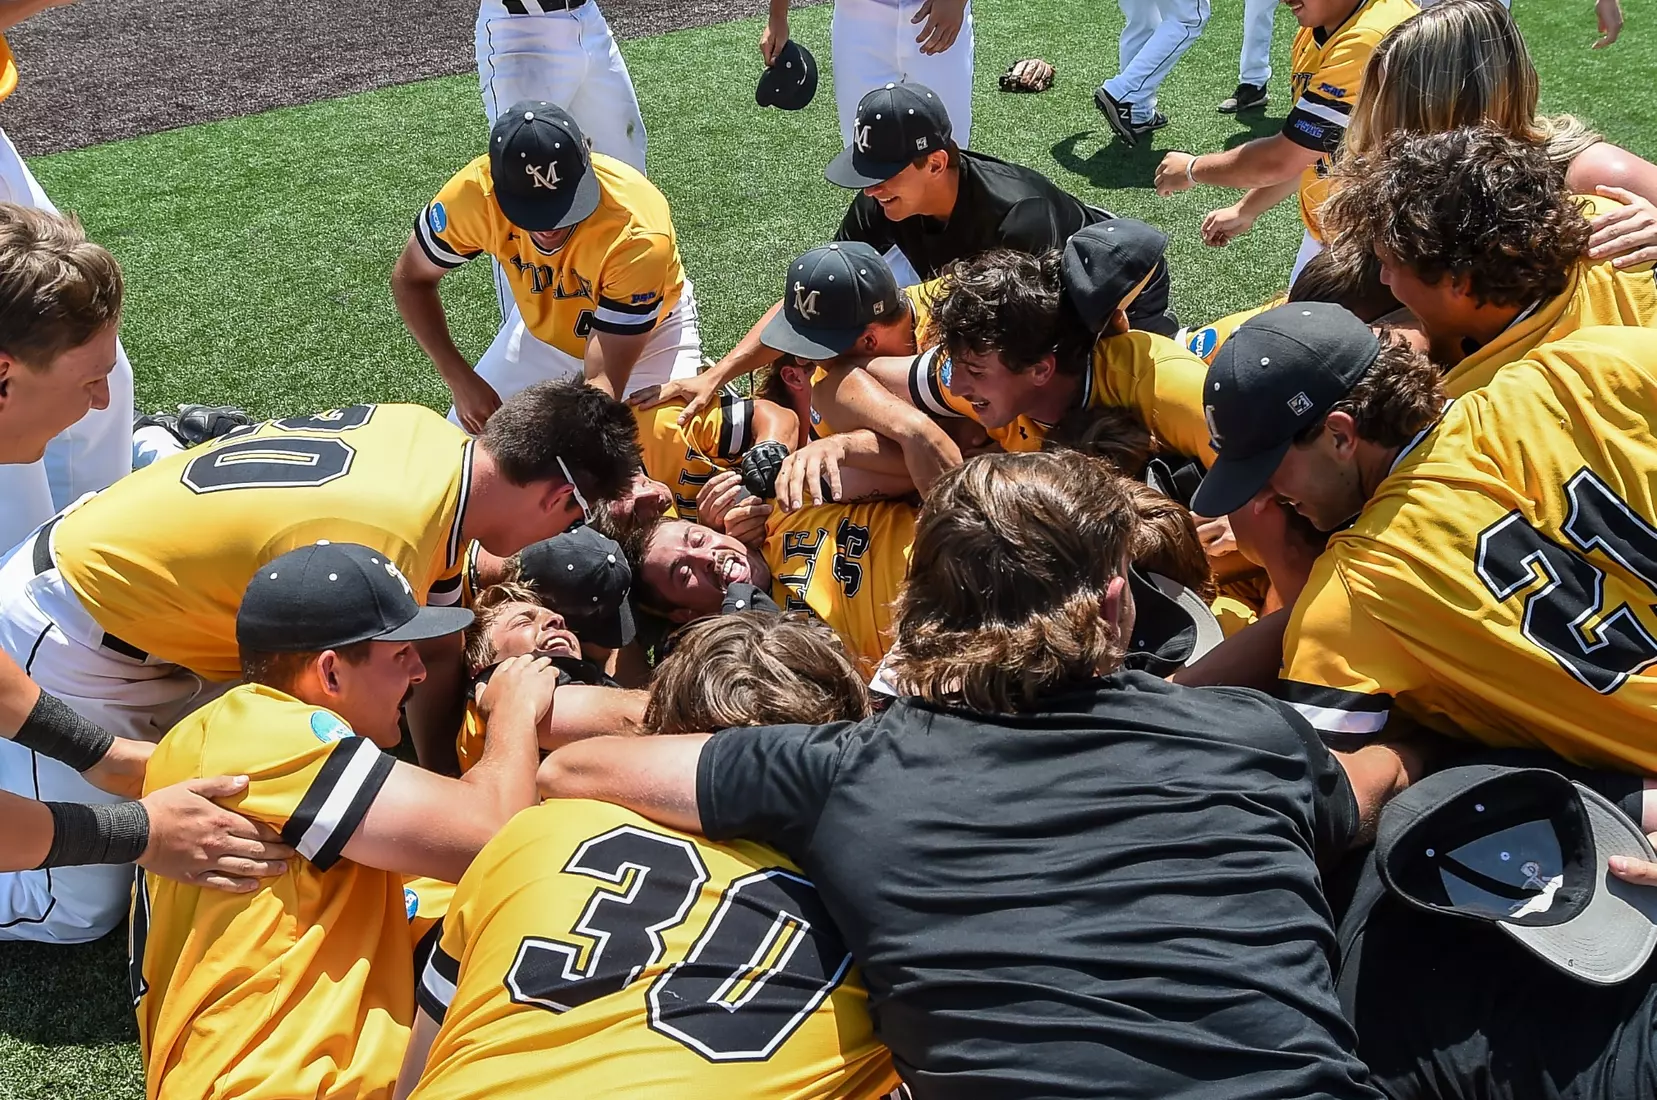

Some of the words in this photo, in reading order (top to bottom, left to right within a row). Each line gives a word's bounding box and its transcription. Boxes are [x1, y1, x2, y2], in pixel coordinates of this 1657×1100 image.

[1118, 107, 1130, 119] N
[431, 207, 443, 232] NCAA
[1194, 331, 1207, 358] NCAA
[1473, 465, 1657, 695] 21
[503, 823, 855, 1064] 30
